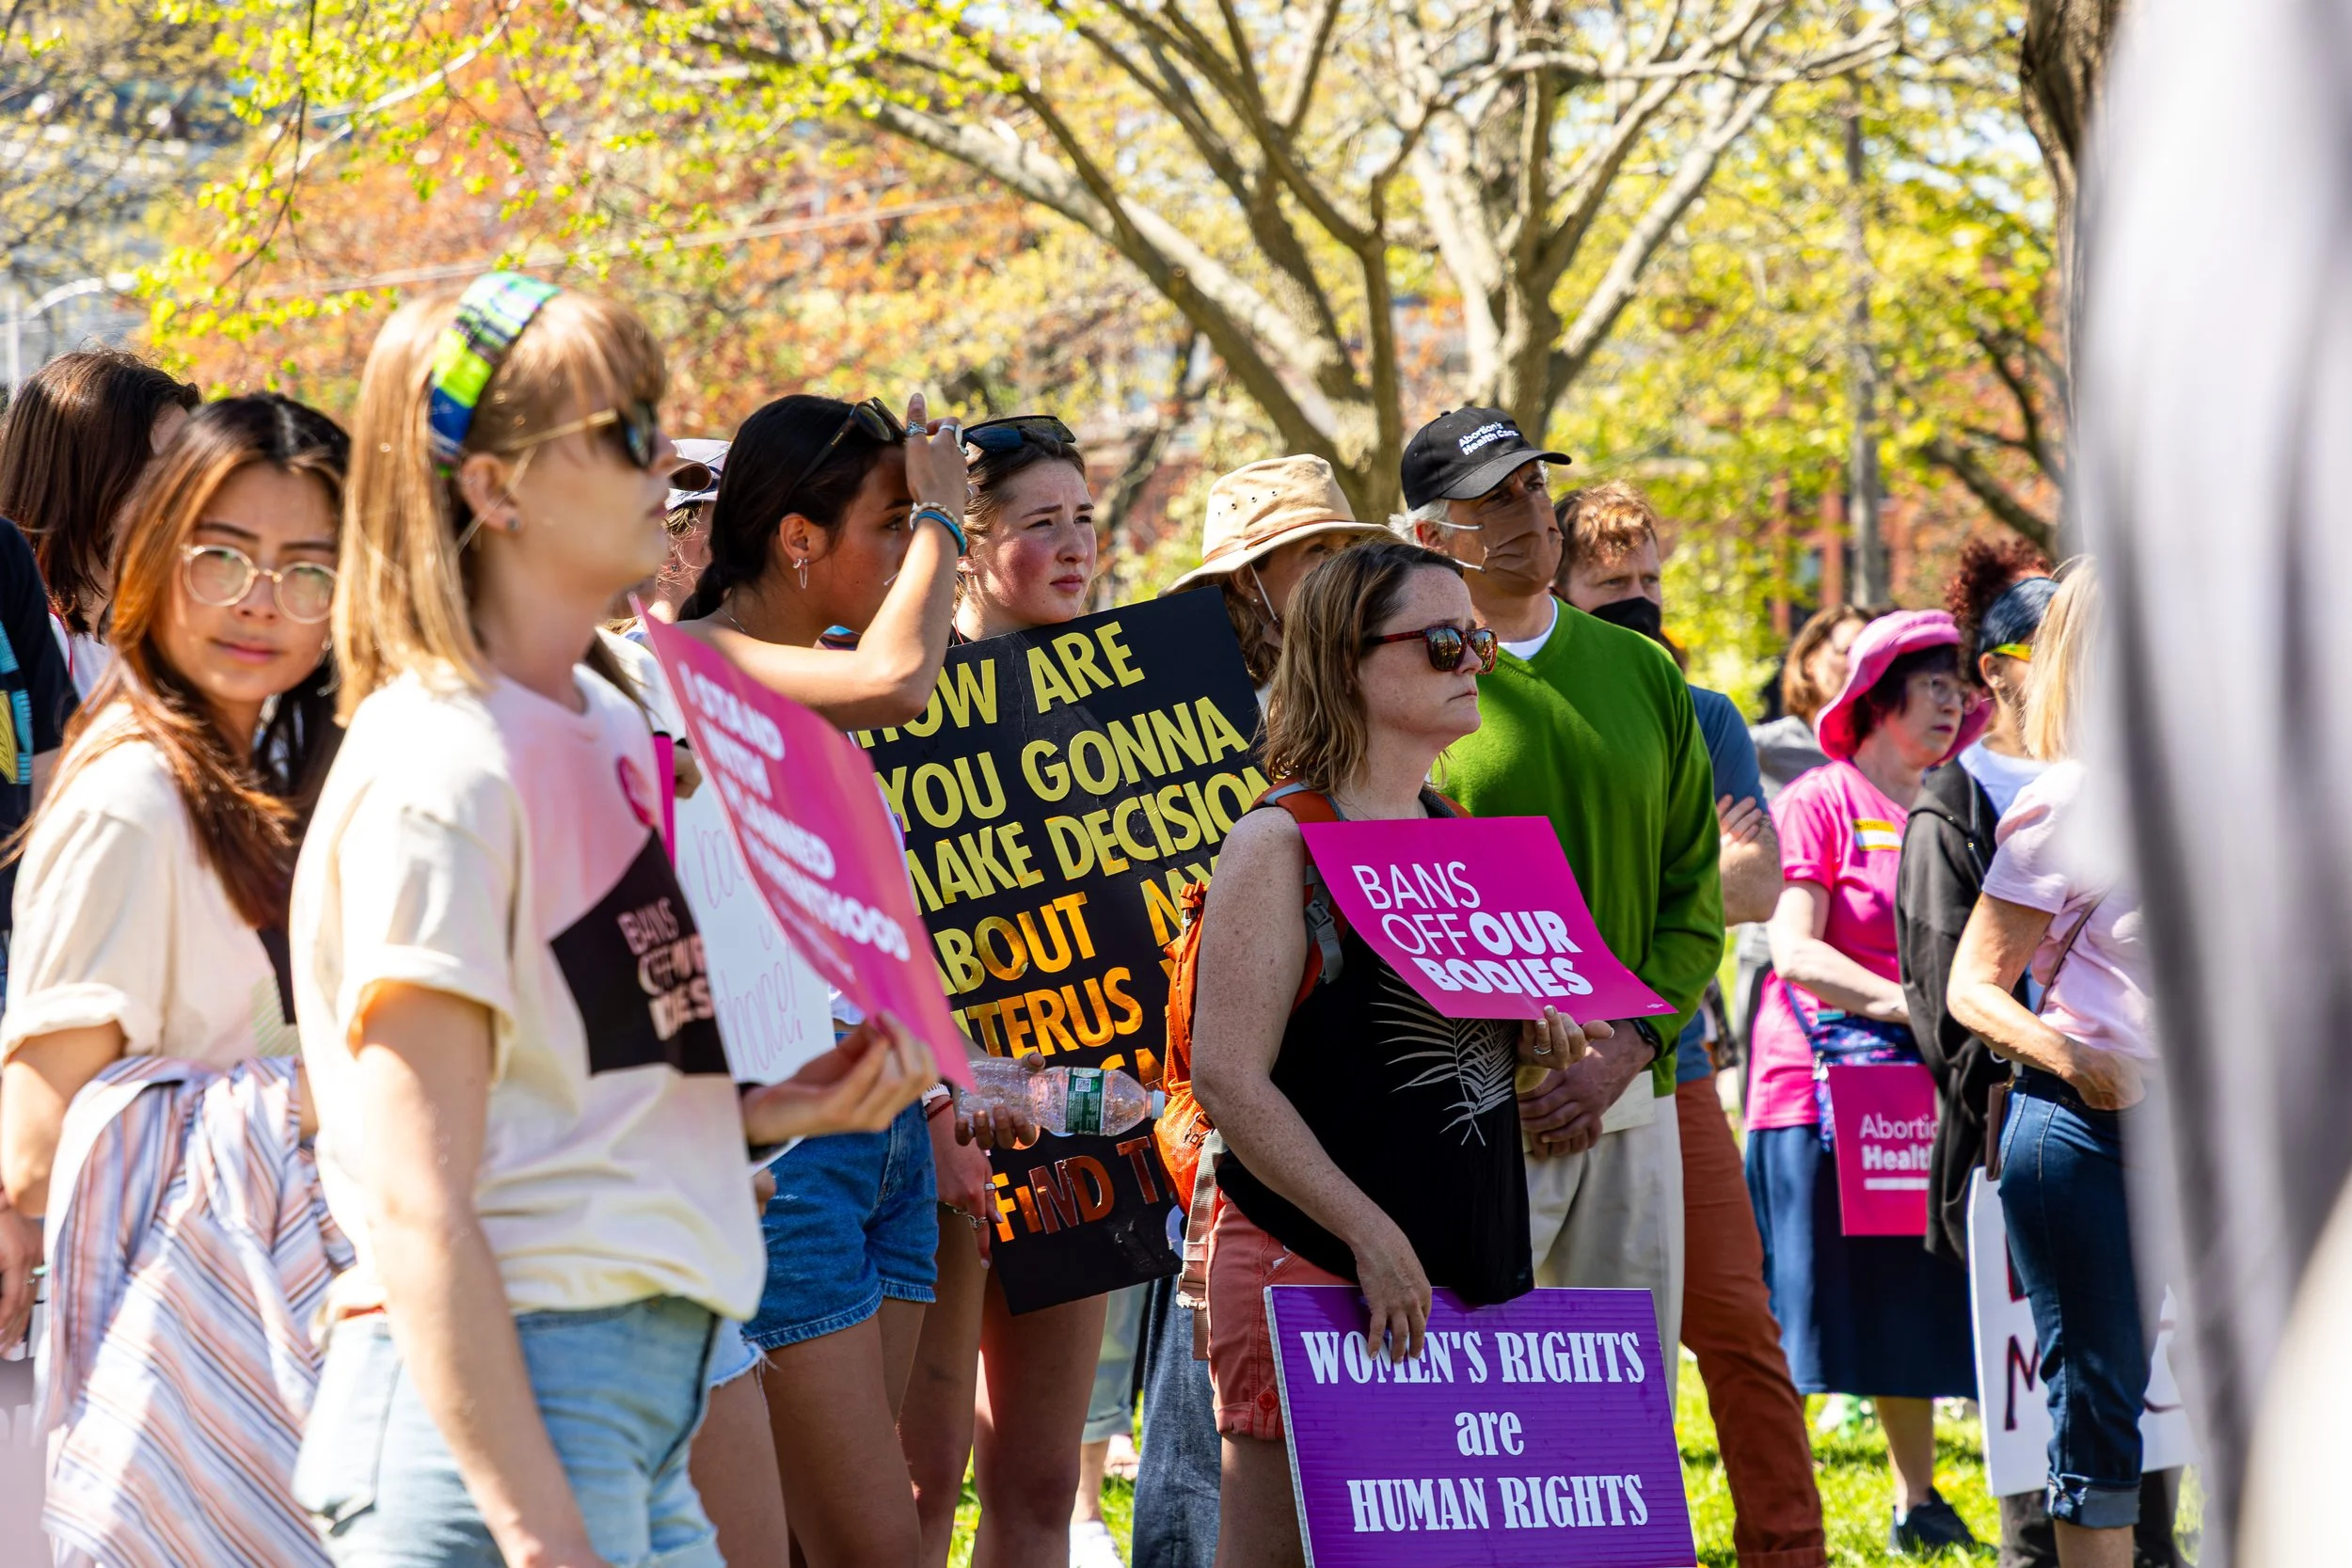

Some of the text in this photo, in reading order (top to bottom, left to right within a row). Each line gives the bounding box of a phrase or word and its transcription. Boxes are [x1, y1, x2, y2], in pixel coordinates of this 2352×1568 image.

[1458, 424, 1498, 448] Abortion
[1462, 433, 1499, 456] Health
[1025, 621, 1146, 715] ARE
[872, 695, 1250, 833] YOU GONNA
[1351, 861, 1482, 910] BANS
[930, 891, 1096, 998] BOUT
[1381, 910, 1583, 956] OFF OUR
[1411, 957, 1594, 998] BODIES
[950, 966, 1144, 1059] TERUS
[1859, 1112, 1941, 1139] Abortio
[1494, 1330, 1645, 1384] RIGHTS
[1454, 1411, 1525, 1456] are
[1346, 1474, 1649, 1533] HUMAN RIGHTS
